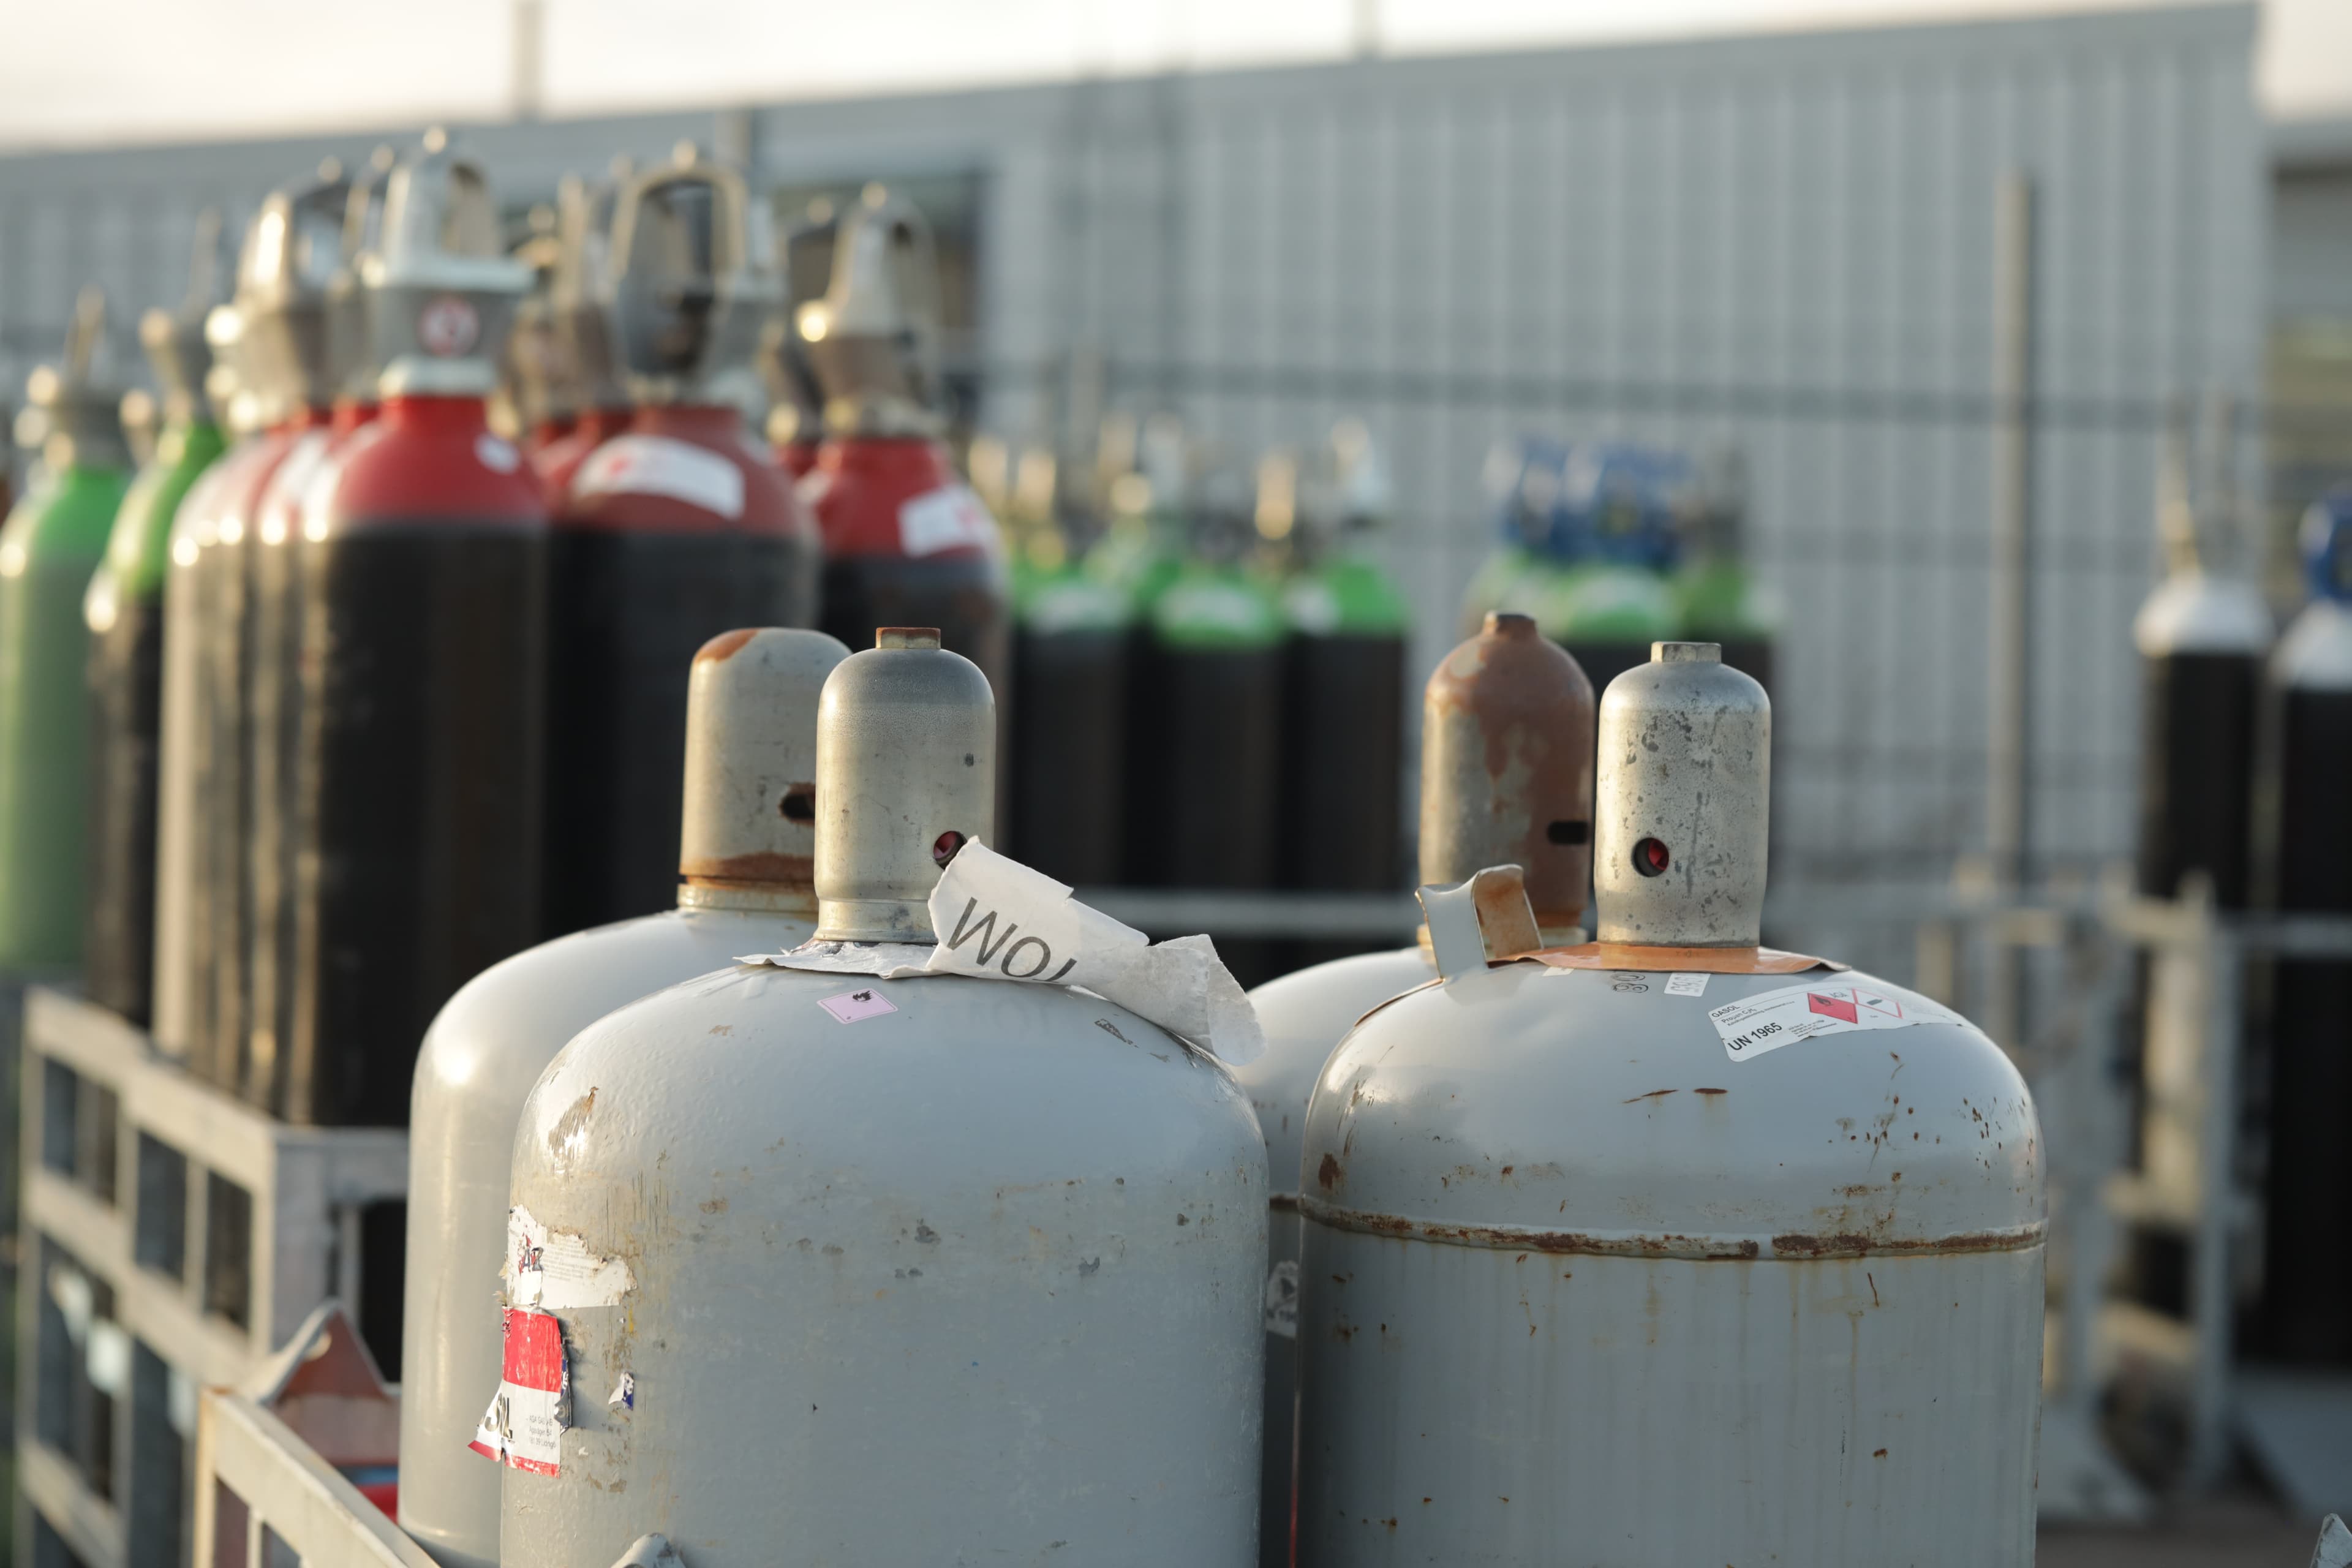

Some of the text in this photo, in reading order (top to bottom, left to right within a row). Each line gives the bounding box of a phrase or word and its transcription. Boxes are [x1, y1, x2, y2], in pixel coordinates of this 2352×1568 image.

[1711, 1005, 1741, 1018] GASOL
[1727, 1035, 1753, 1050] UN
[1751, 1022, 1782, 1039] 1965
